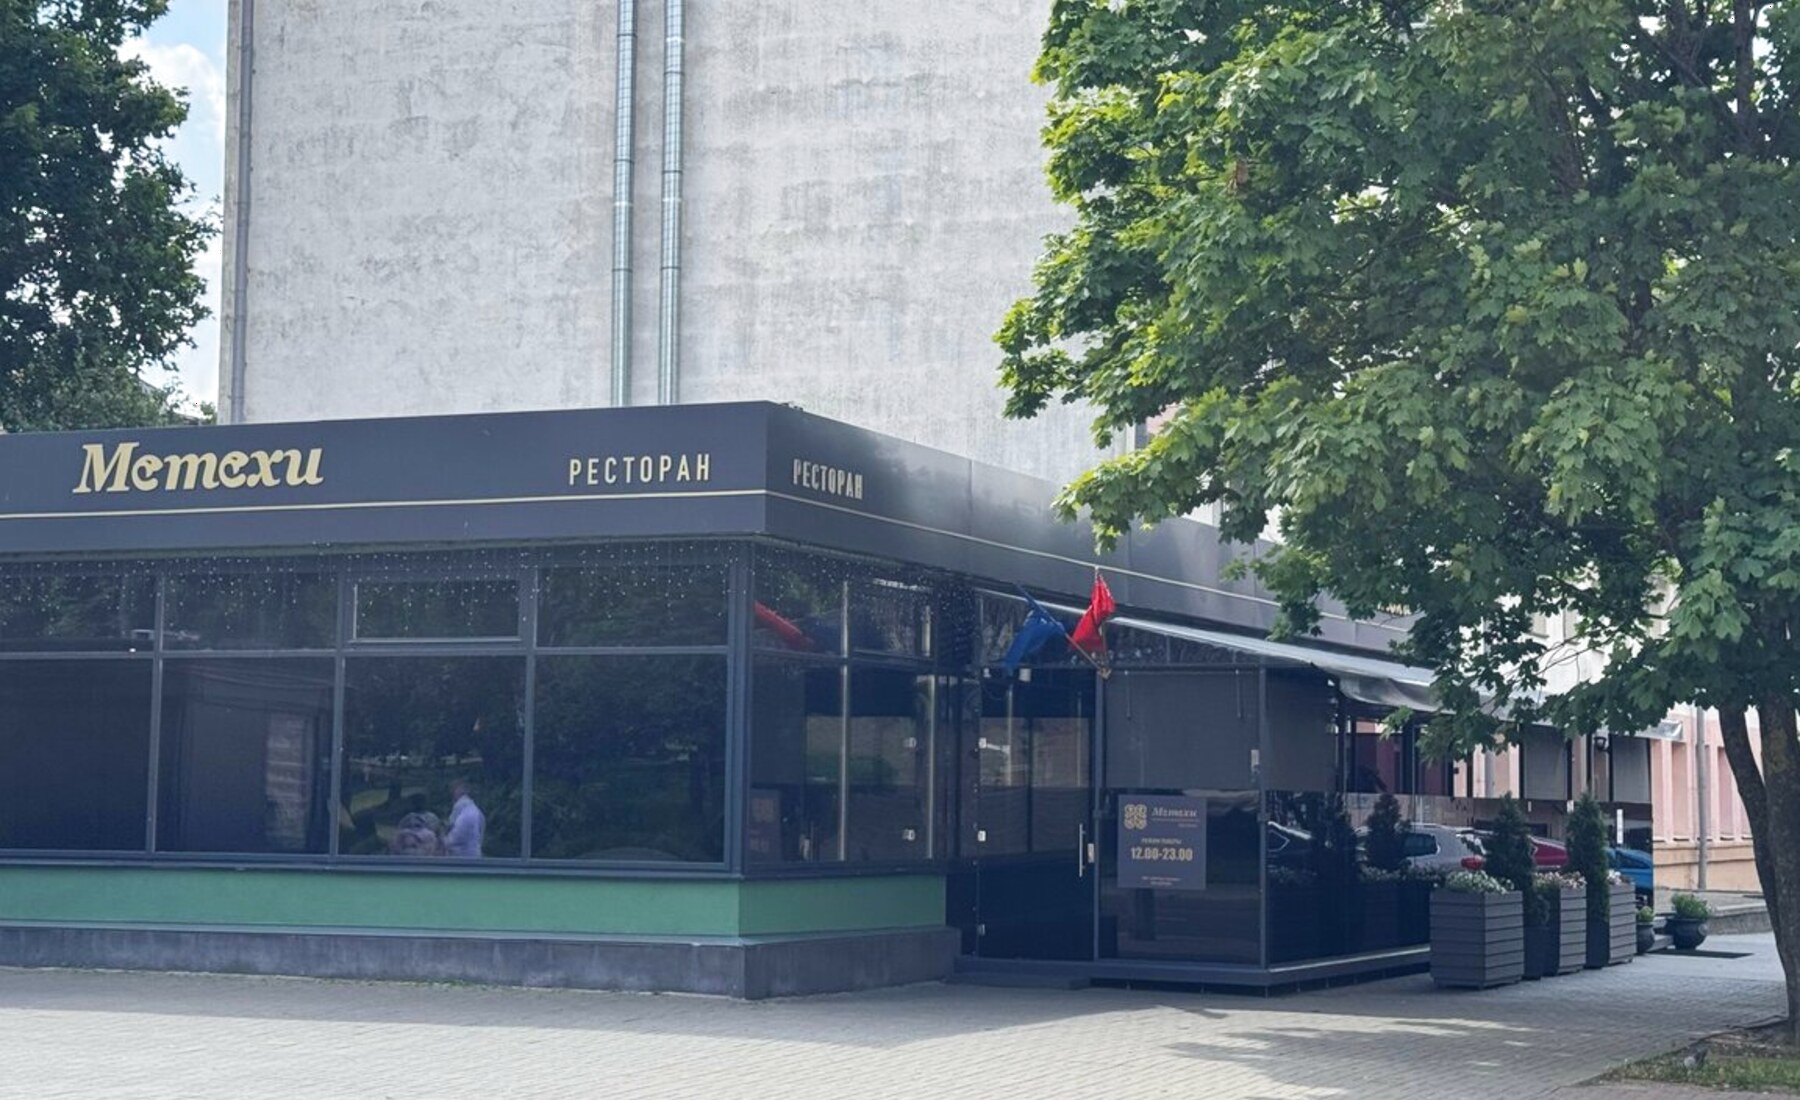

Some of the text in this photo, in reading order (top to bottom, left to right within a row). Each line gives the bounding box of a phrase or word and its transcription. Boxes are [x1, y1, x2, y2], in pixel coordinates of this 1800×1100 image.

[72, 442, 325, 494] Метехи
[568, 453, 711, 486] РЕСТОРАН
[792, 458, 864, 500] РЕСТОРАН
[1130, 847, 1193, 861] 12.00-23.00
